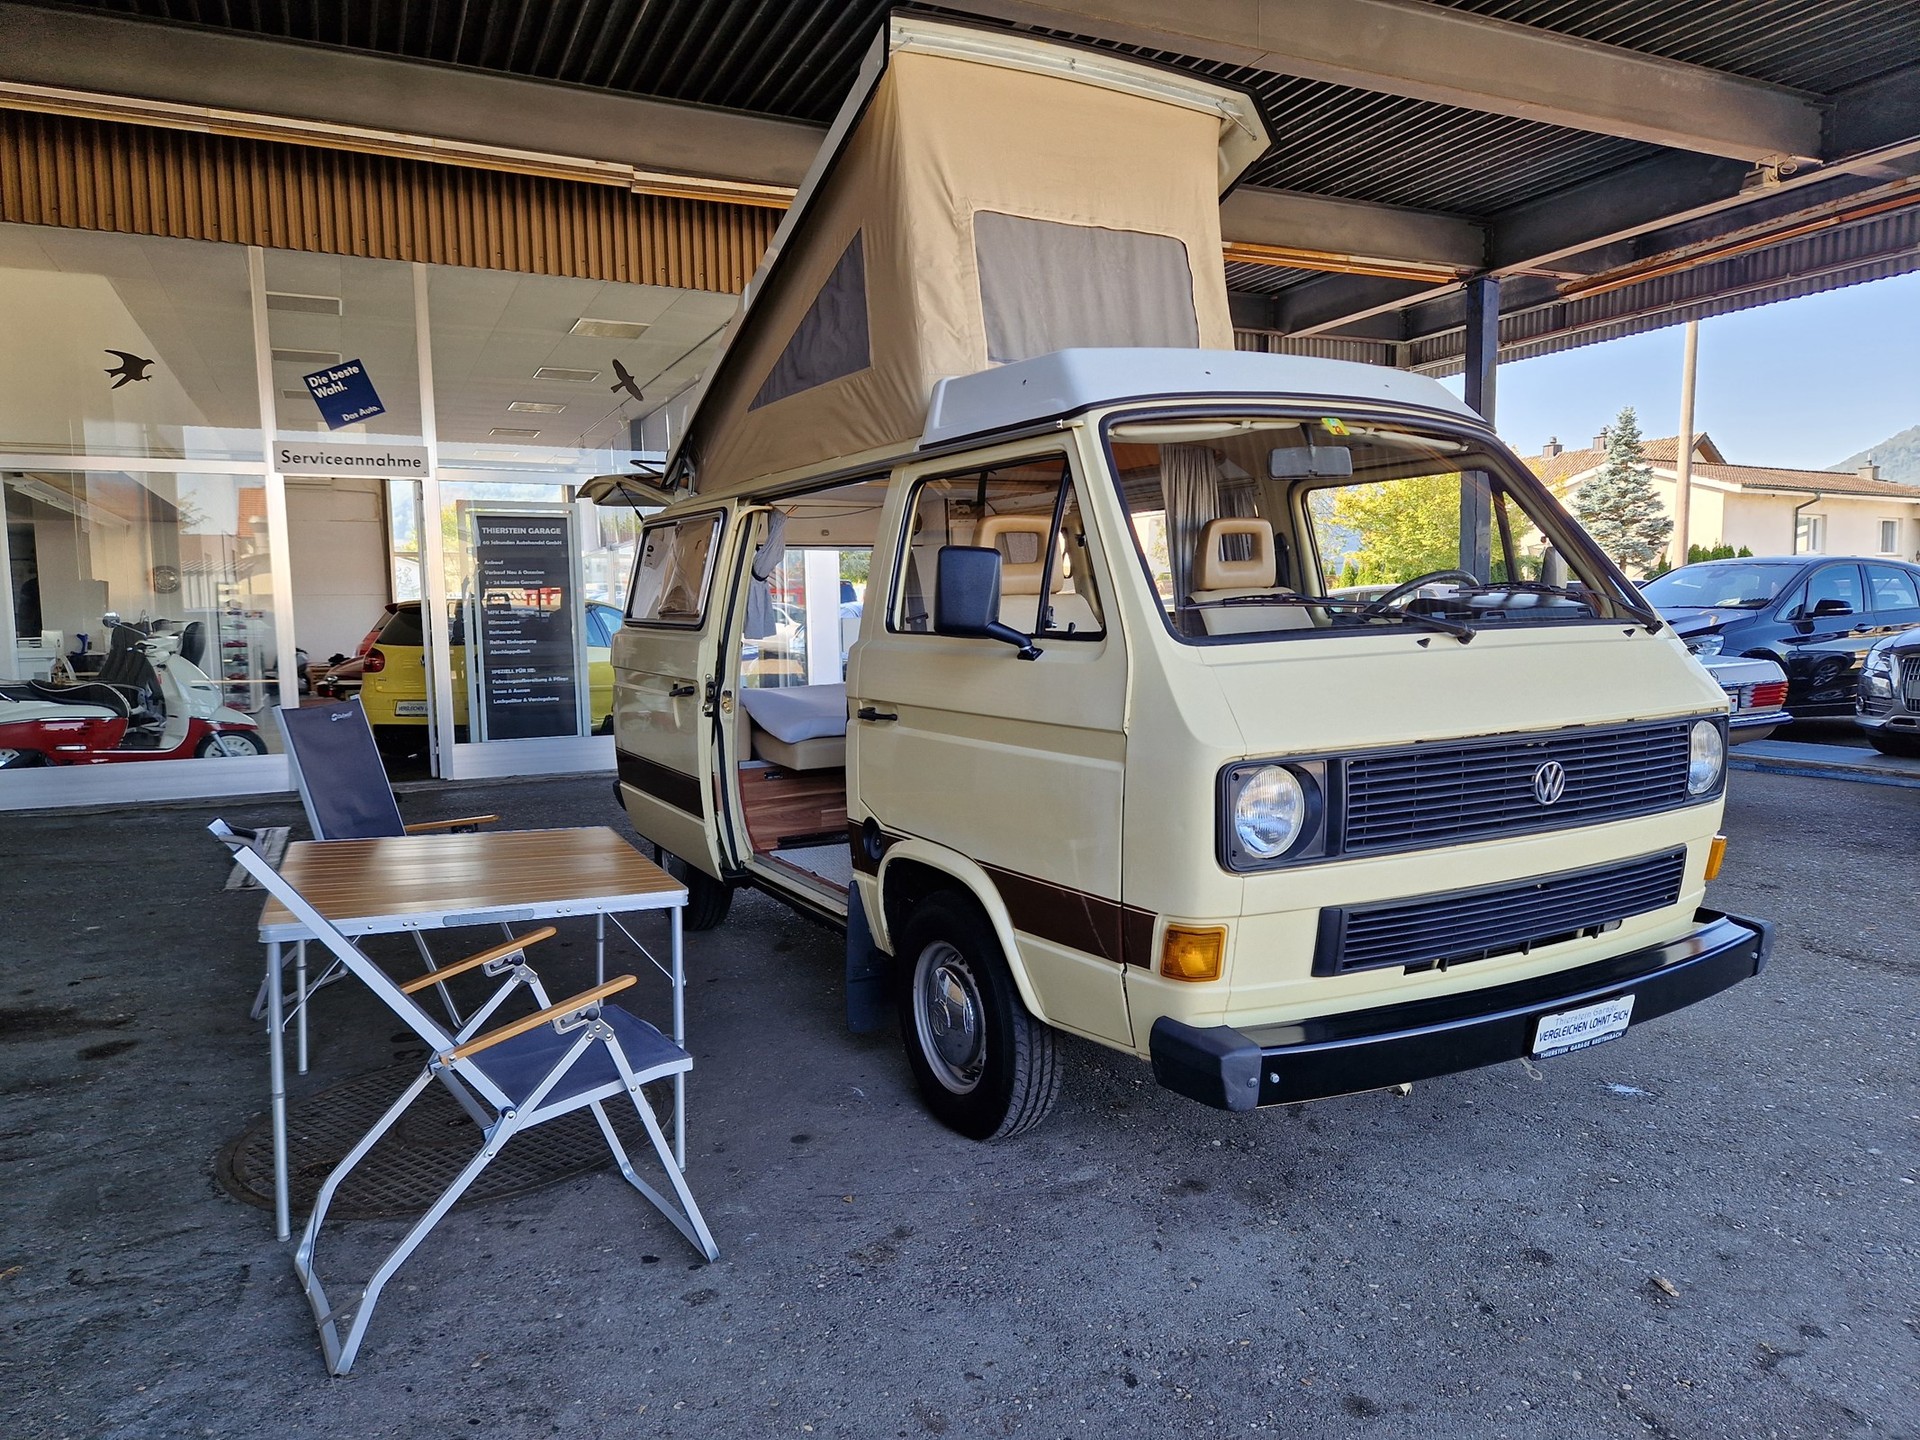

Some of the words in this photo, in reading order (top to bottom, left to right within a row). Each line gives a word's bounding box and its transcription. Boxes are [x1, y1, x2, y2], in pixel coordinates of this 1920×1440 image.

[308, 375, 329, 388] Die
[329, 365, 360, 381] beste
[314, 381, 348, 399] Wahl.
[342, 411, 359, 422] Das
[360, 405, 381, 416] Auto.
[281, 449, 422, 468] Serviceannahme
[1539, 1021, 1587, 1042] VERGLEICHEN
[1589, 1014, 1612, 1029] LOHNT
[1612, 1009, 1629, 1022] SICH
[1540, 1046, 1569, 1059] THIERSTEIN
[1569, 1040, 1591, 1051] GARAGE
